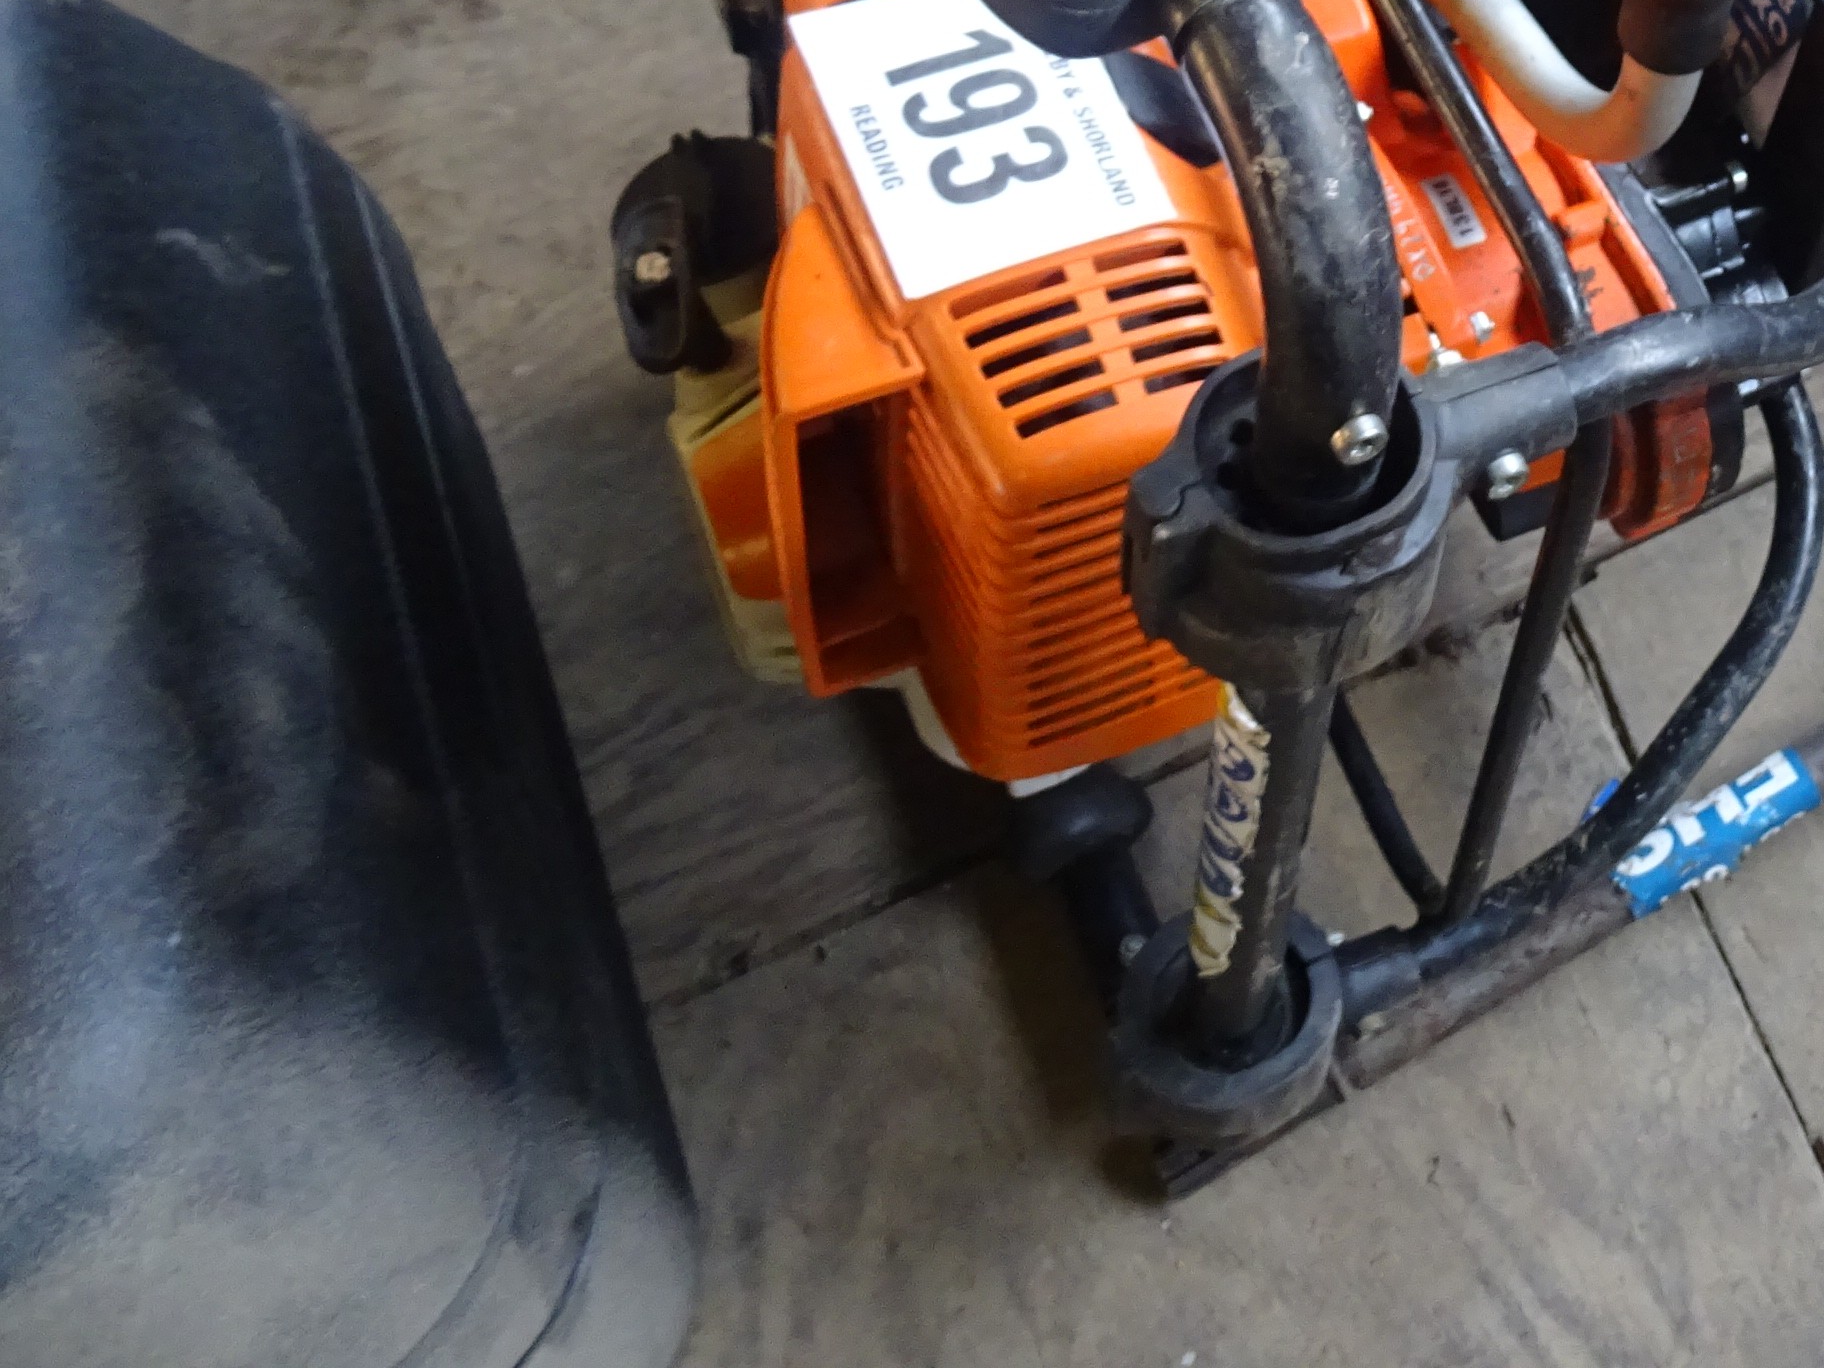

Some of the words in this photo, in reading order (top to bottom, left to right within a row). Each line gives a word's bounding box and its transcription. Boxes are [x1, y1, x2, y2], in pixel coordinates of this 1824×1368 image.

[850, 104, 904, 191] READING
[884, 29, 1069, 205] 193
[1062, 86, 1083, 99] &
[1073, 106, 1136, 208] SHORLAND
